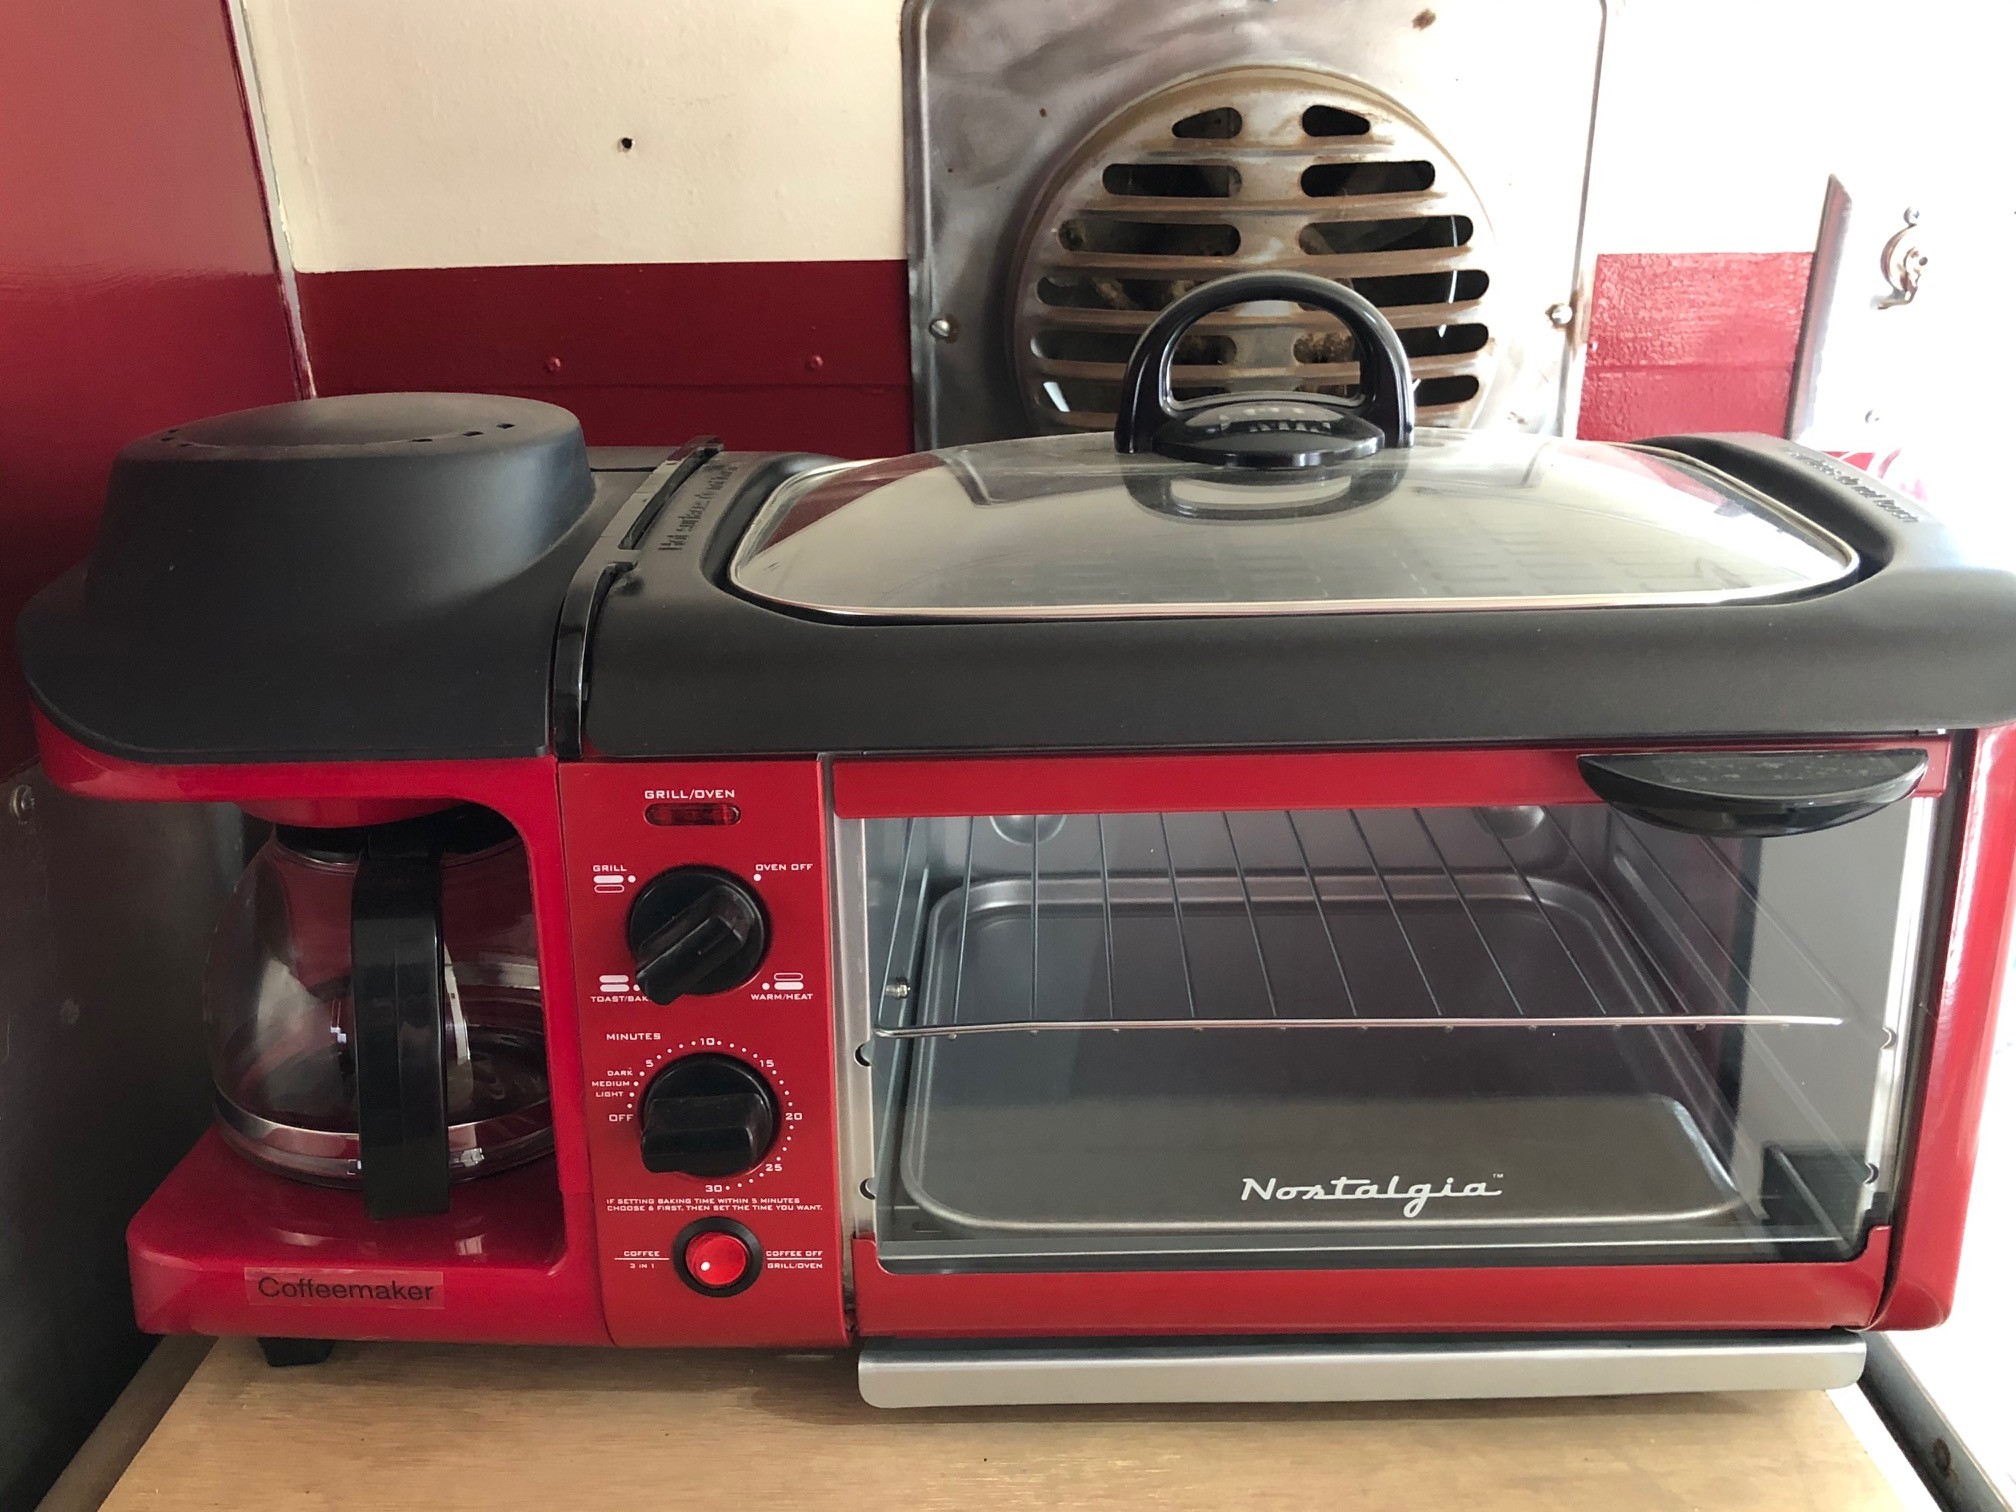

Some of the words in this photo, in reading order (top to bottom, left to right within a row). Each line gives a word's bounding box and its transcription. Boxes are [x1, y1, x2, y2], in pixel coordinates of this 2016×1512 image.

[644, 789, 735, 800] GRILL/OVEN
[592, 864, 627, 872] GRILL
[755, 863, 787, 872] OVEN
[790, 863, 813, 871] OFF
[590, 995, 652, 1003] TOAST/BAK
[750, 993, 814, 1001] WARM/HEAT
[606, 1032, 661, 1041] MINUTES
[700, 1037, 715, 1046] 10
[645, 1059, 654, 1068] 5
[759, 1059, 775, 1068] 15
[608, 1113, 634, 1122] OFF
[785, 1112, 803, 1121] 20
[765, 1163, 783, 1172] 25
[705, 1184, 723, 1193] 30
[1241, 1175, 1502, 1218] Nostalgia
[258, 1277, 433, 1300] Coffeemaker
